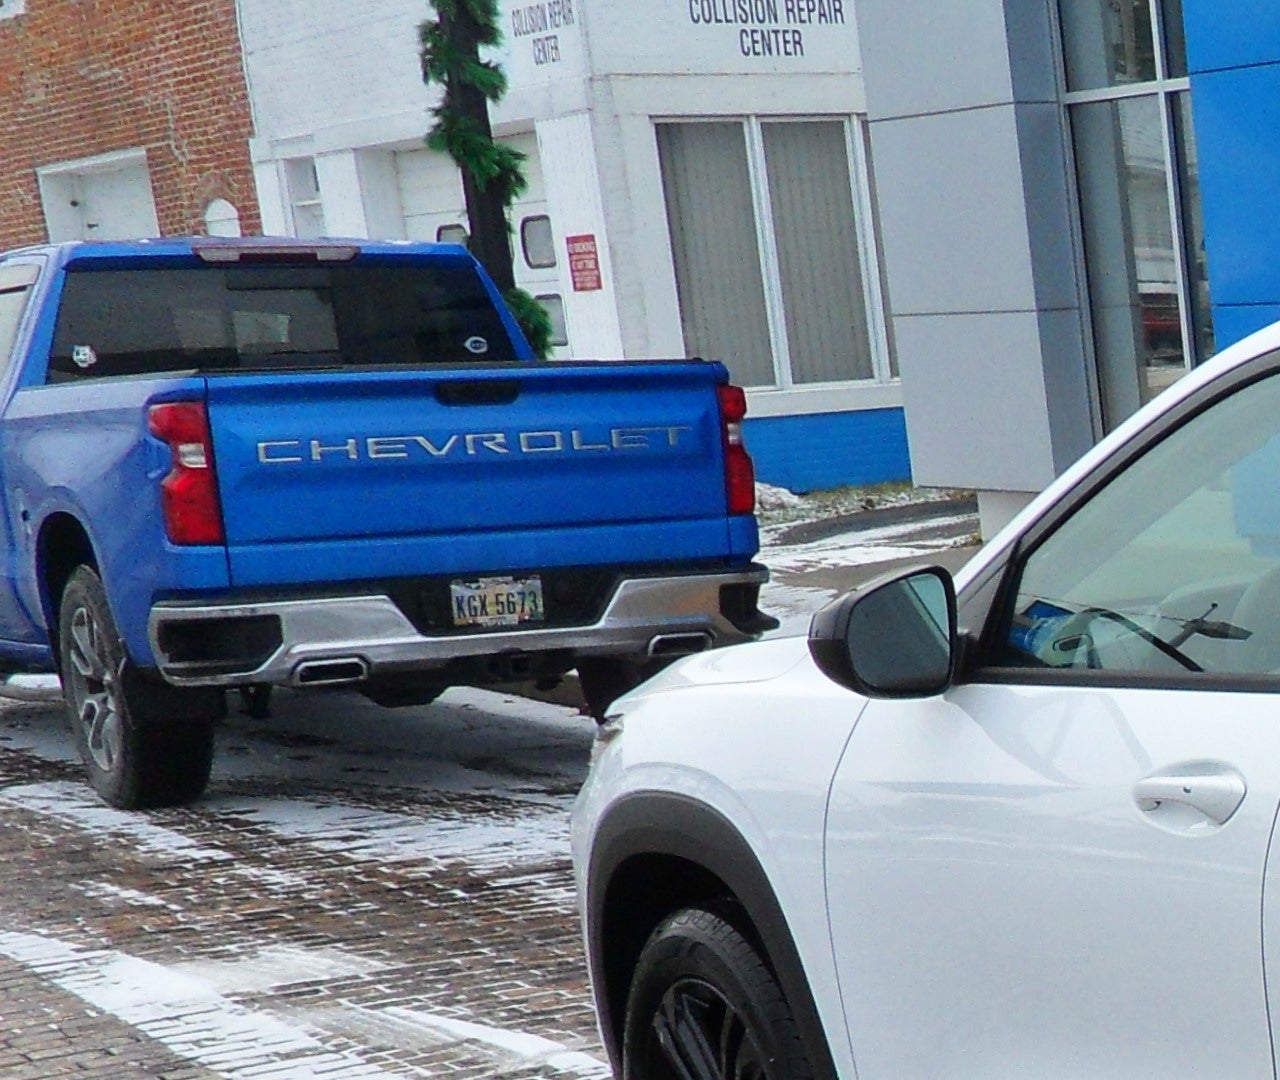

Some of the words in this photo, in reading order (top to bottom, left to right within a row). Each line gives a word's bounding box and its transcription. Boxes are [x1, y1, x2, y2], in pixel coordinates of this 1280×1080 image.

[512, 4, 547, 37] COLLISION
[548, 0, 575, 29] REPAIR
[689, 0, 778, 24] COLLISION
[786, 0, 845, 24] REPAIR
[533, 35, 560, 65] CENTER
[740, 28, 804, 56] CENTER
[257, 425, 692, 463] CHEVROLET
[455, 594, 489, 618] KGX
[495, 591, 538, 615] 5673
